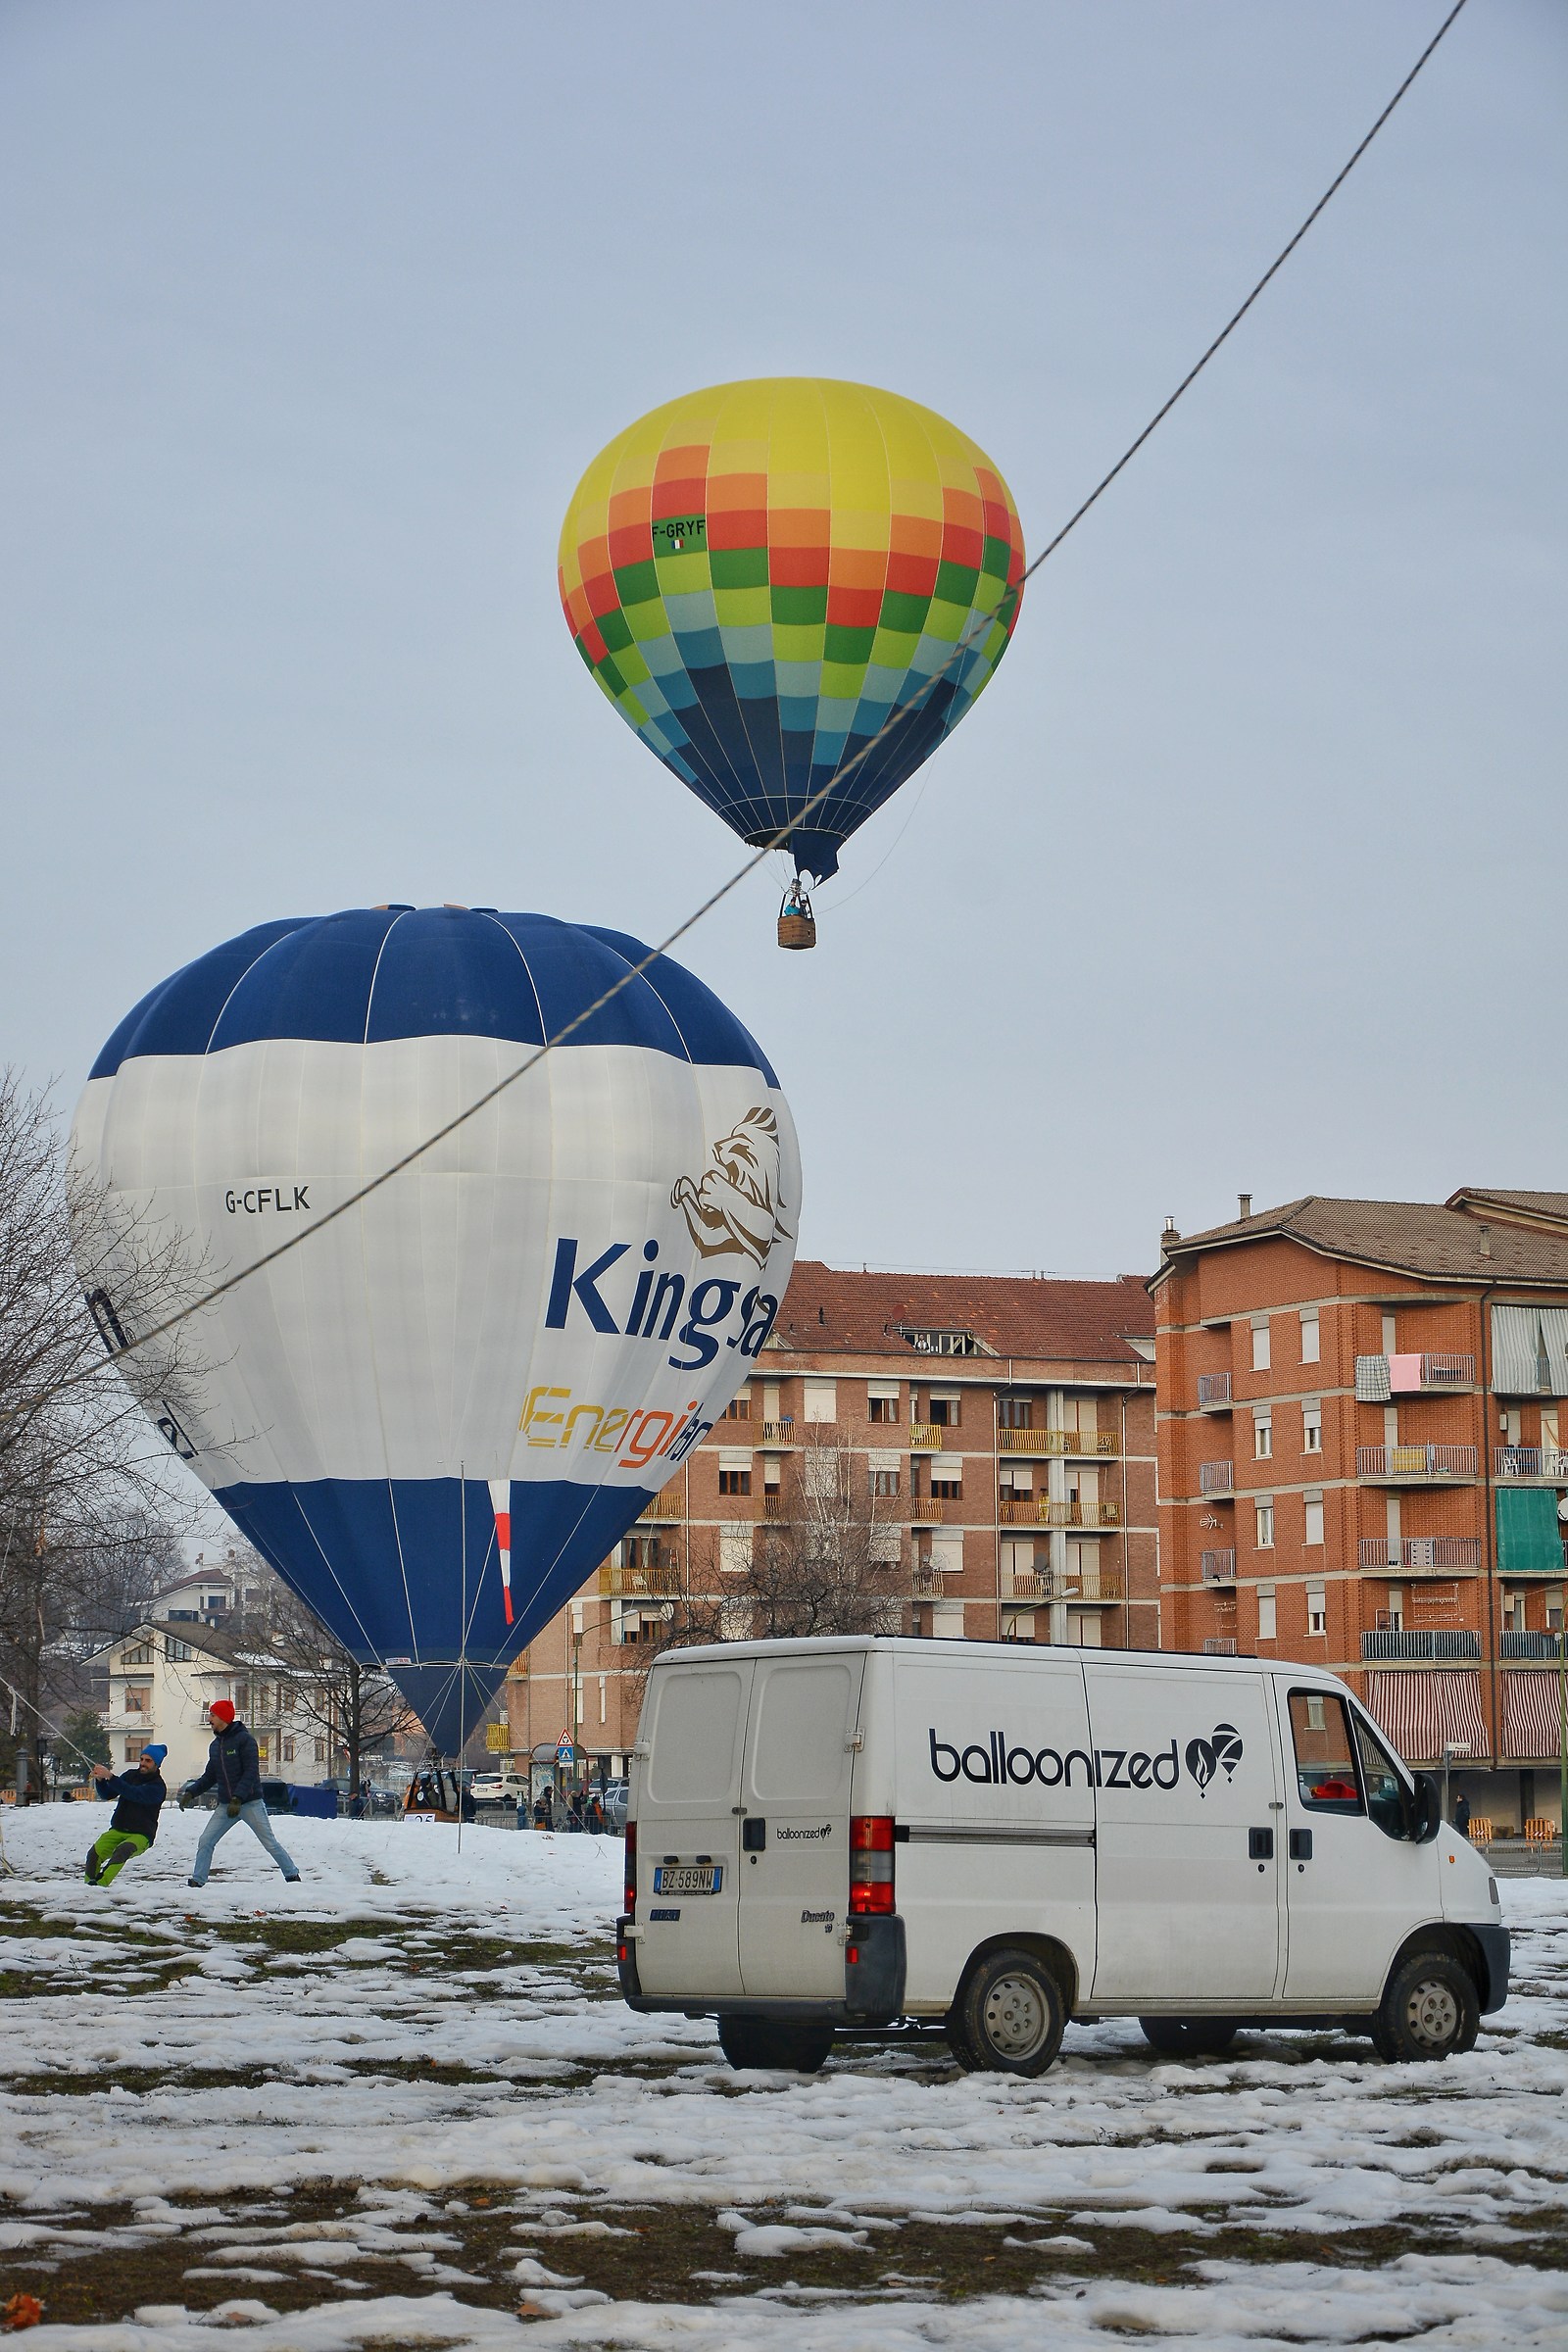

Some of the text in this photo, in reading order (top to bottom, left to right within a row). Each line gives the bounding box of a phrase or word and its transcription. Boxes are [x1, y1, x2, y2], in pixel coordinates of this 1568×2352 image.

[652, 519, 706, 541] F-GRYF
[225, 1186, 311, 1214] G-CFLK
[928, 1728, 1180, 1790] balloonized
[776, 1827, 820, 1839] balloonized
[801, 1909, 835, 1923] Ducato
